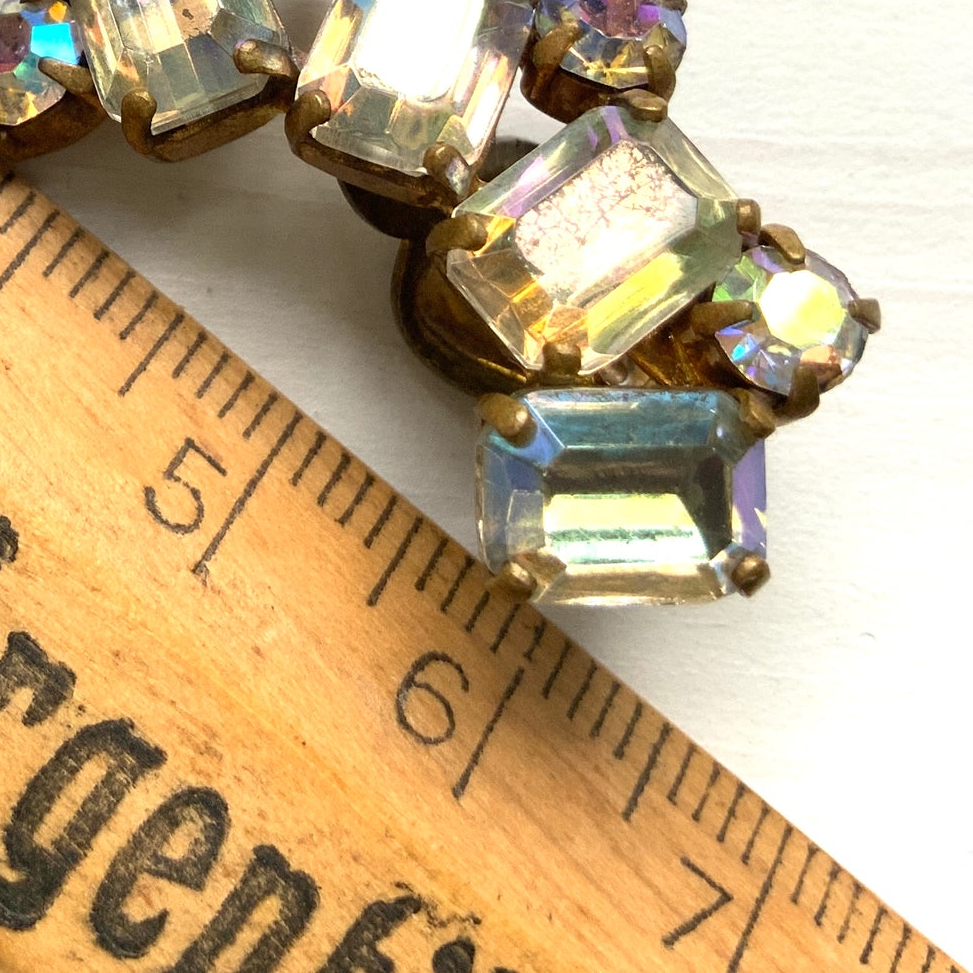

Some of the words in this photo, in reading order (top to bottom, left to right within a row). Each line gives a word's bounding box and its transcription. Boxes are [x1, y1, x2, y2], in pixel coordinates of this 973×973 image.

[143, 437, 227, 535] 5
[395, 651, 470, 746] 6
[662, 856, 733, 948] 7
